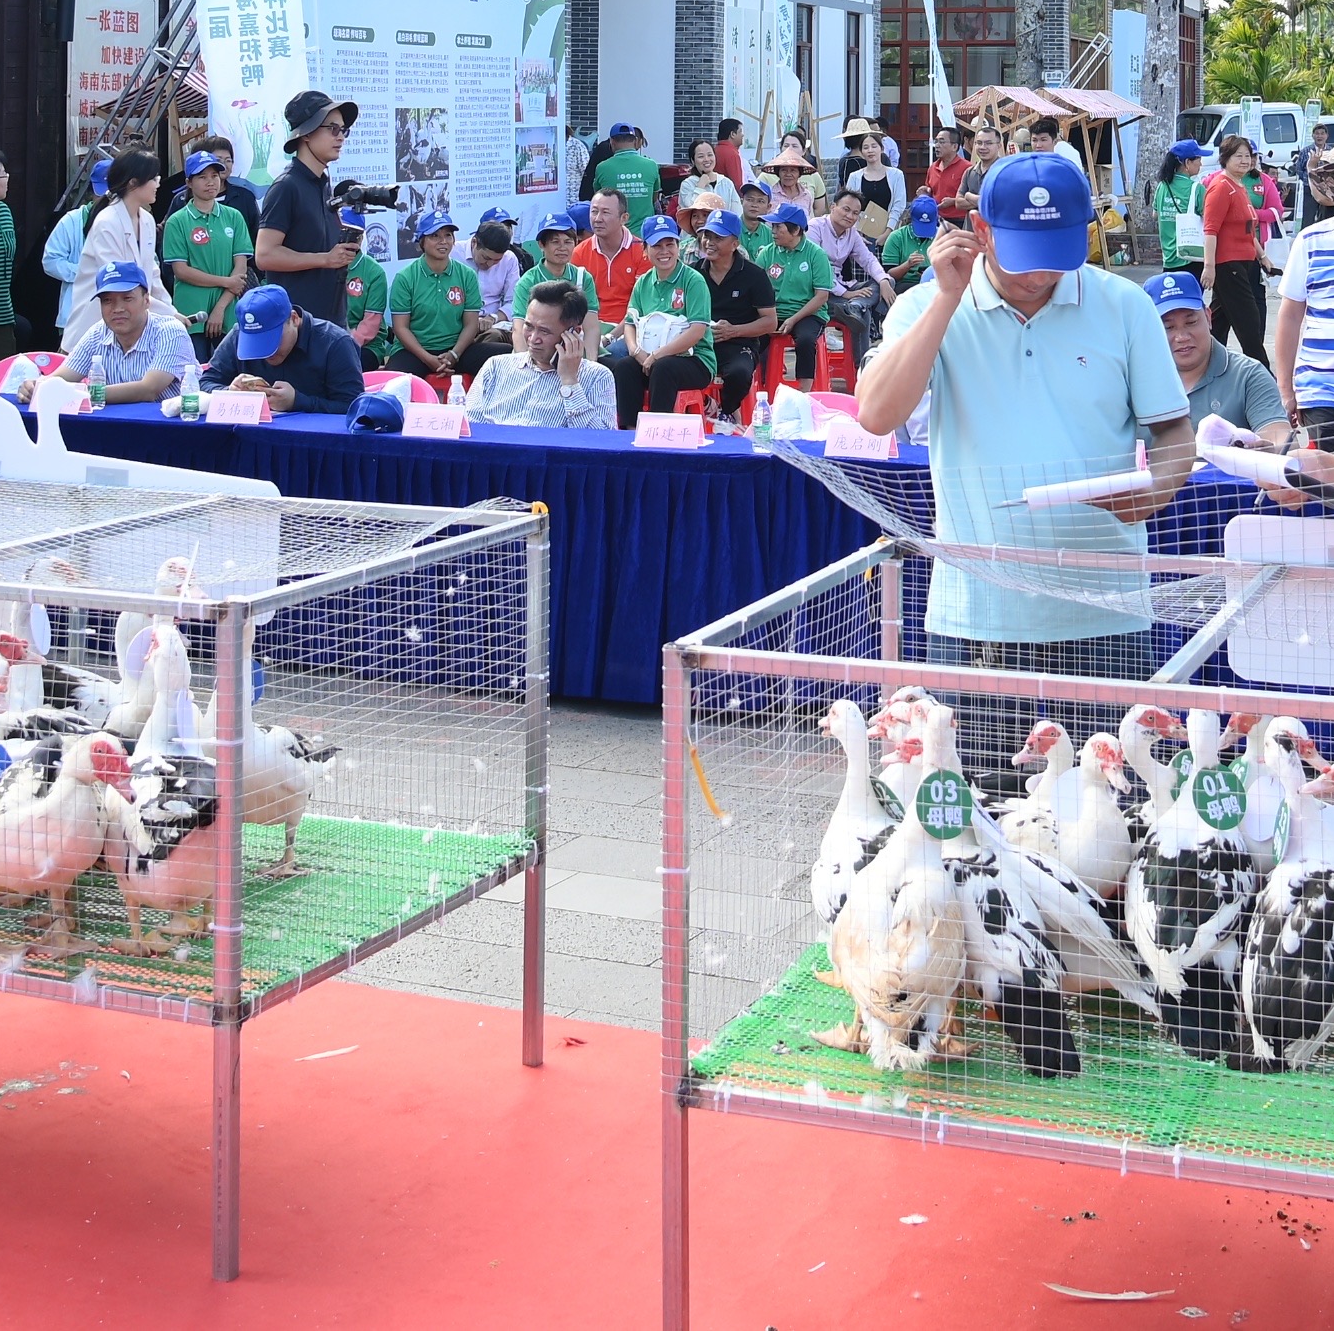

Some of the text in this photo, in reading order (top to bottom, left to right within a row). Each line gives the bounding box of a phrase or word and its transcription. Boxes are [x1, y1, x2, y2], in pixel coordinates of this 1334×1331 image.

[85, 9, 139, 34] 一张蓝图
[101, 45, 146, 66] 加快建设
[193, 230, 206, 242] 05
[770, 266, 781, 276] 09
[348, 280, 362, 292] 03
[448, 291, 461, 301] 06
[217, 402, 255, 418] 易伟鹏
[930, 779, 958, 803] 03
[1202, 772, 1230, 797] 01
[927, 807, 963, 829] 母鸭
[1207, 794, 1242, 821] 母鸭
